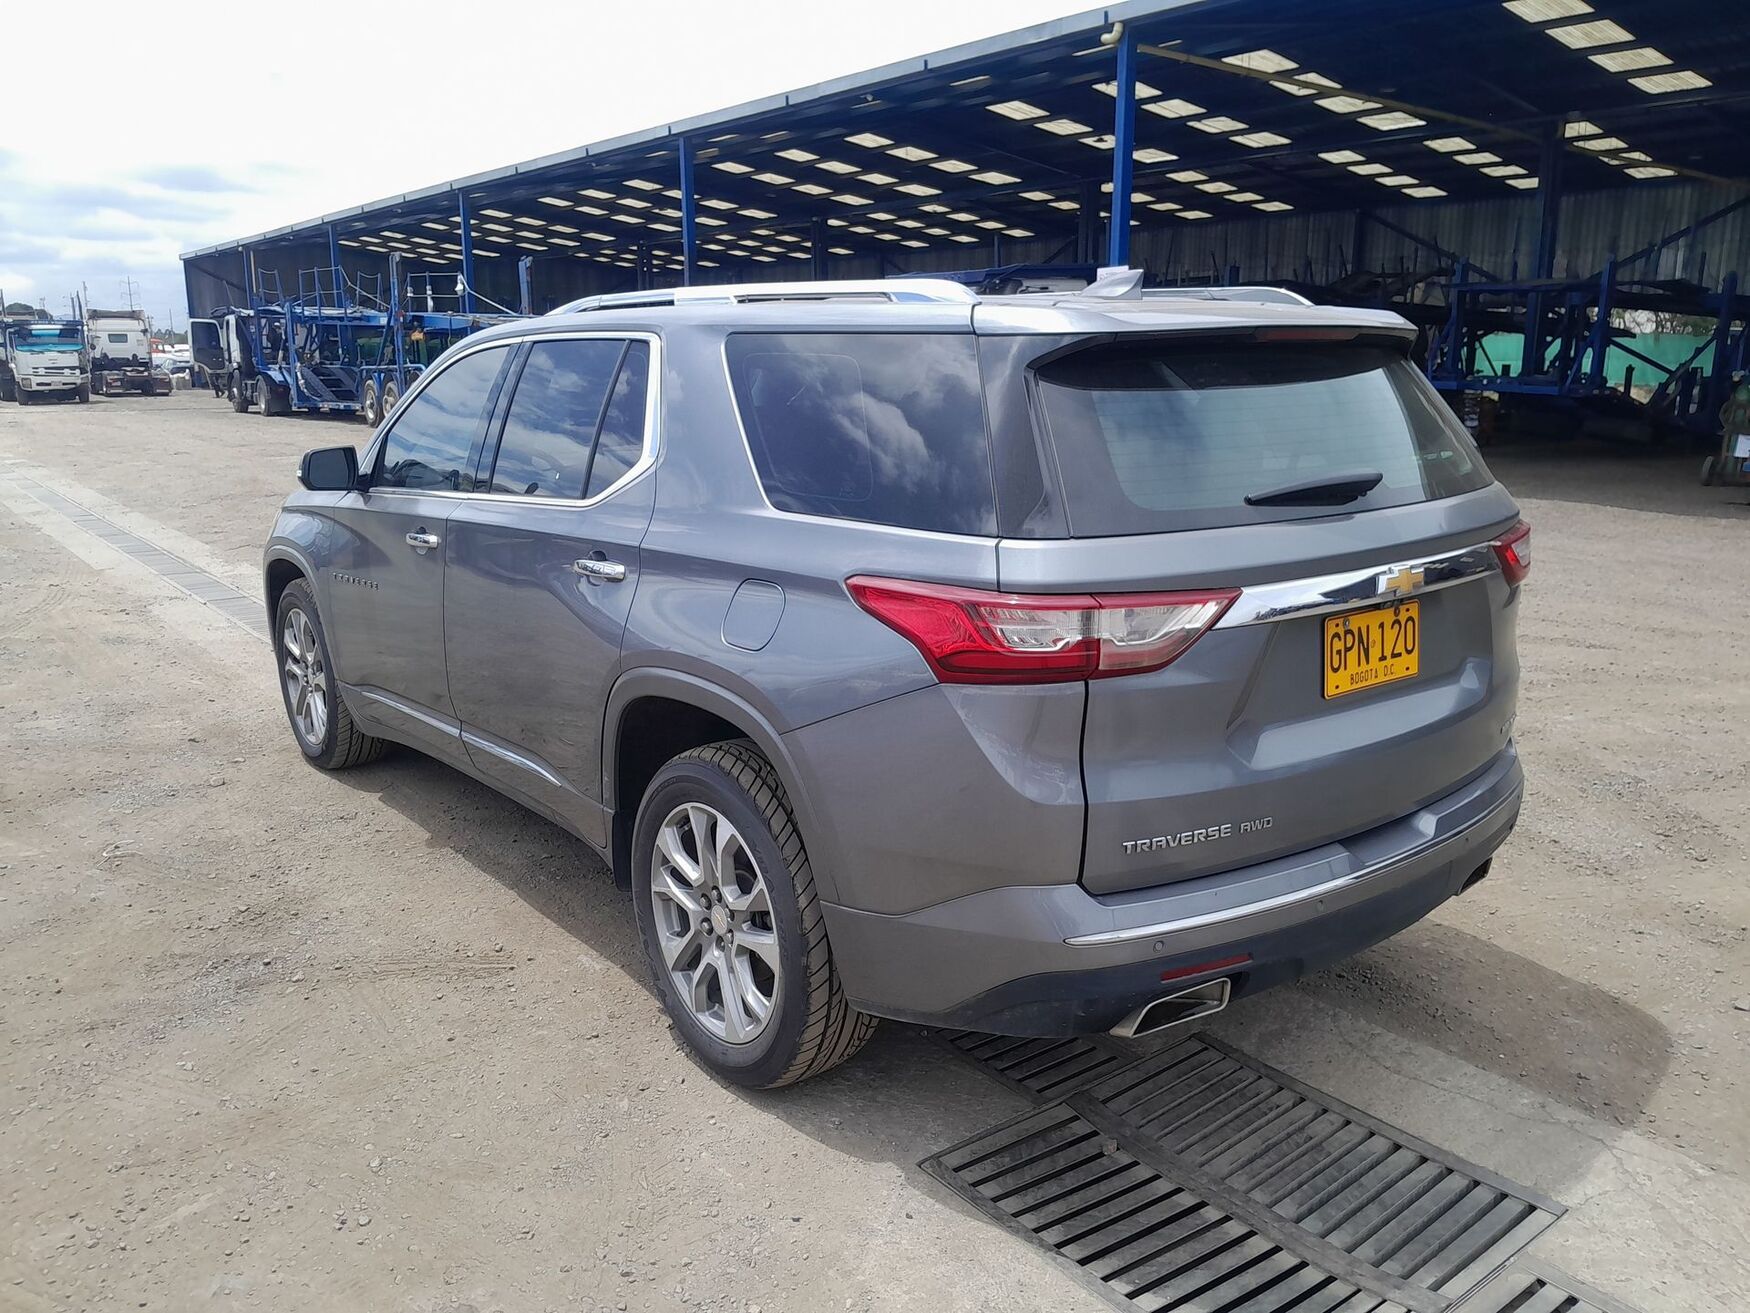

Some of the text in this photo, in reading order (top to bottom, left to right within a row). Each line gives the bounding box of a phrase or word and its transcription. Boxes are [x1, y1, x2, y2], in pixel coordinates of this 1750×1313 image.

[1350, 668, 1379, 686] BOGOTA
[1122, 816, 1274, 855] TRAVERSE AWD
